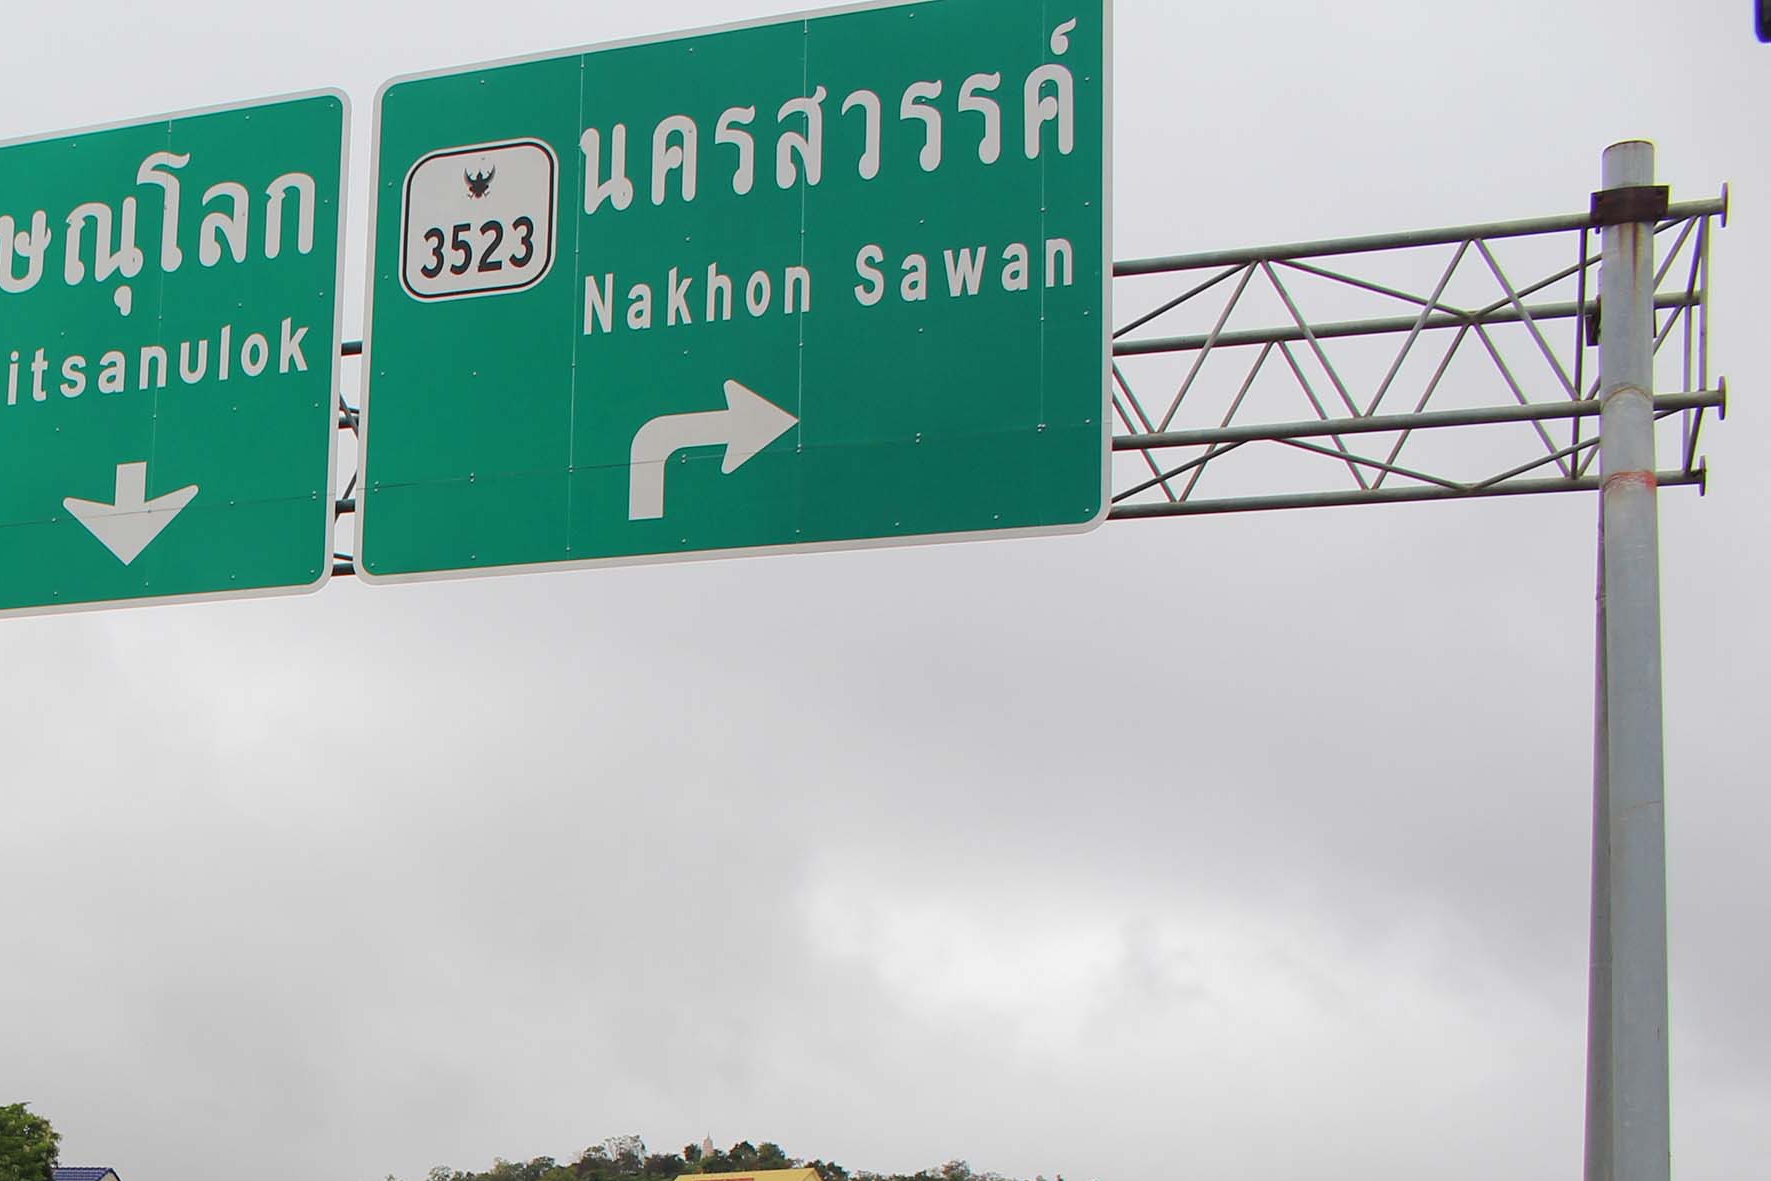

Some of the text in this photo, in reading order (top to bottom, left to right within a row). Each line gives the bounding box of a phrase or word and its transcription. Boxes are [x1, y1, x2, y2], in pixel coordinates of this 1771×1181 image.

[579, 17, 1077, 215] นครสวรรค์
[420, 216, 536, 277] 3523
[583, 236, 1073, 335] Nakhon Sawan
